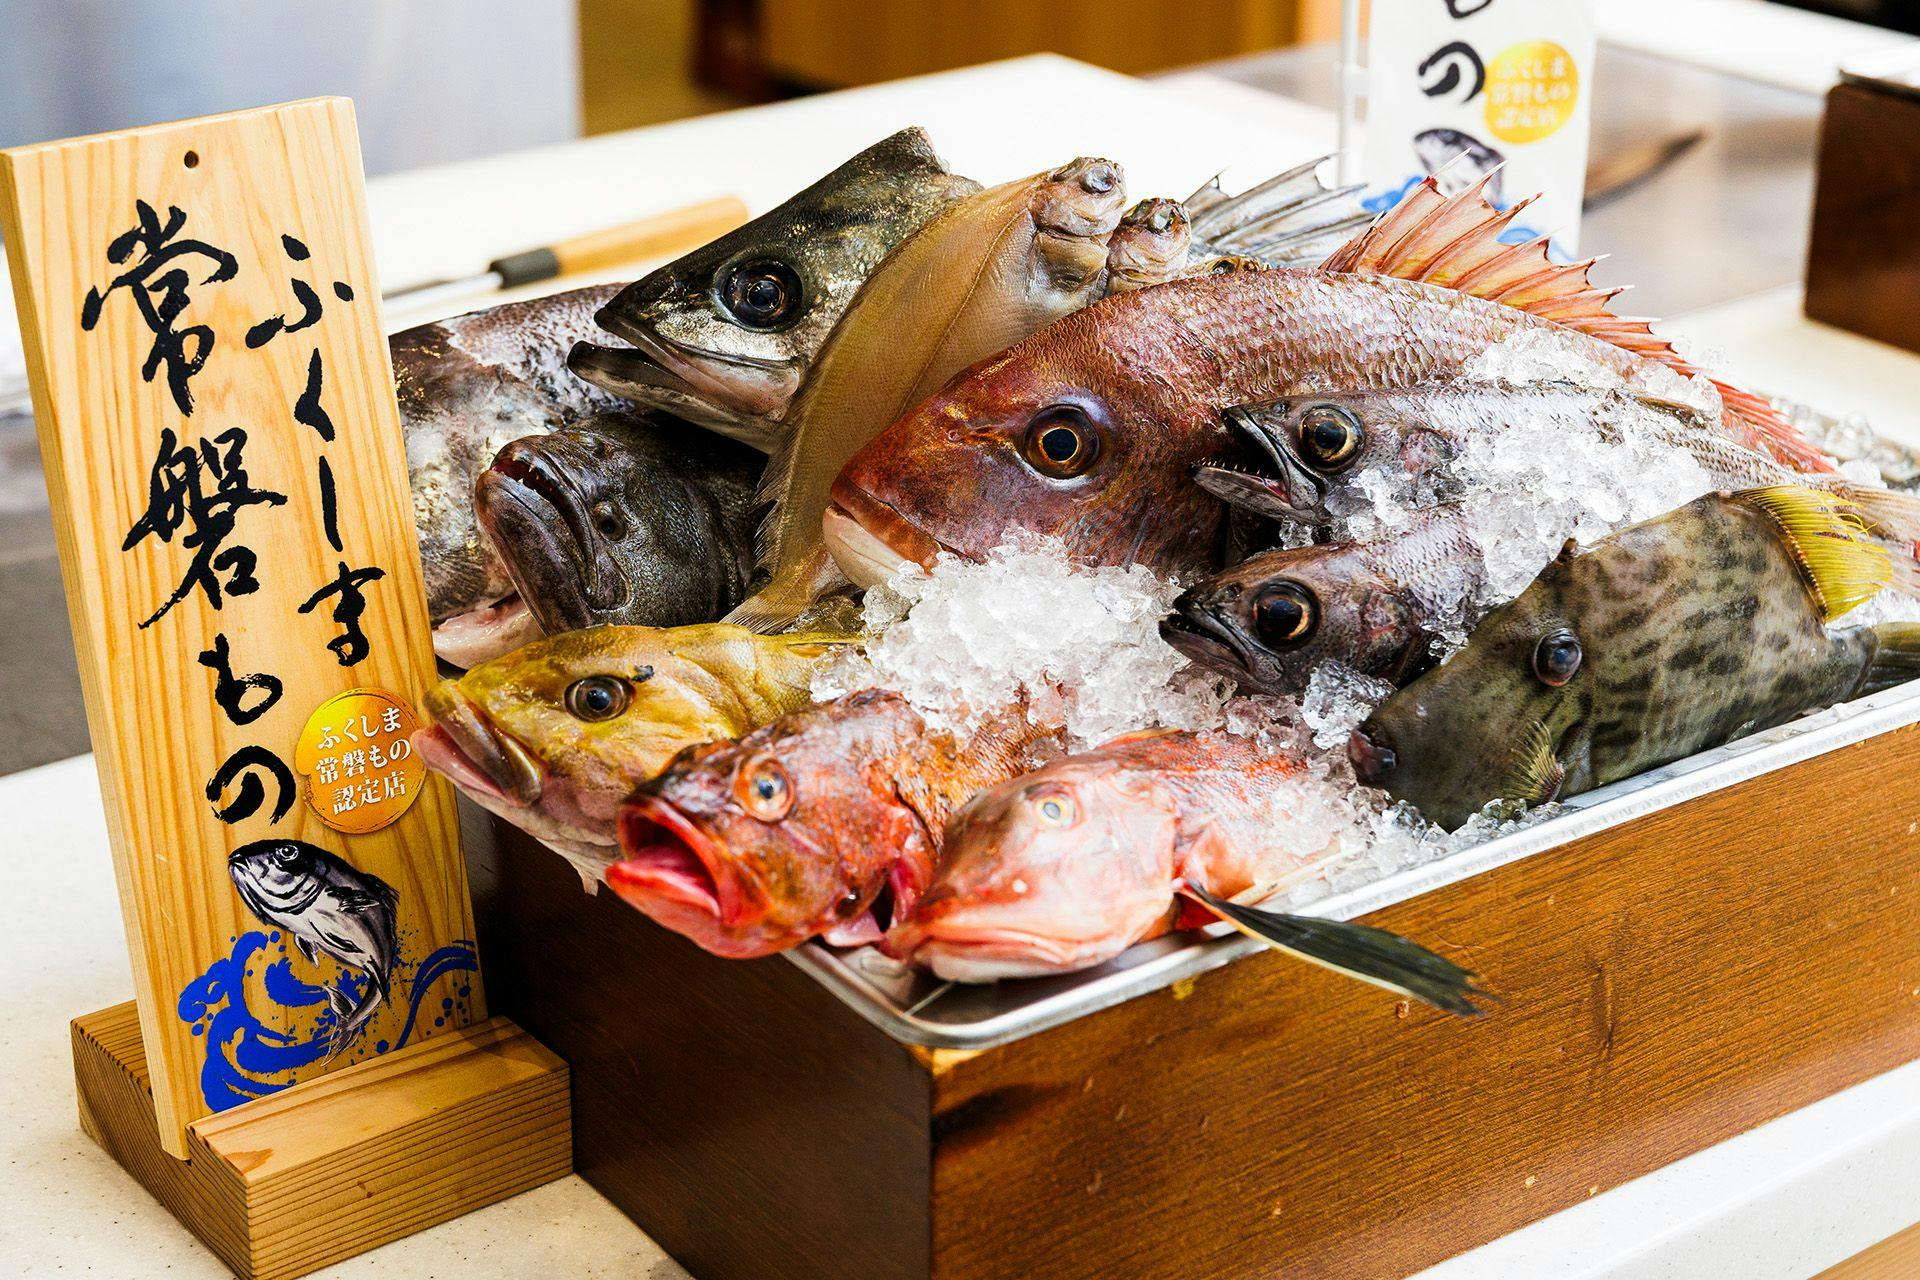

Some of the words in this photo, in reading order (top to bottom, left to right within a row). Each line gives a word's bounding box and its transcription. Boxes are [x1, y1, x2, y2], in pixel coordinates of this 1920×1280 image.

[245, 234, 386, 667] ふくしま
[80, 199, 297, 827] 常磐もの
[317, 707, 402, 750] ふくしま
[316, 738, 411, 785] 常磐もの
[333, 771, 407, 816] 認定店
